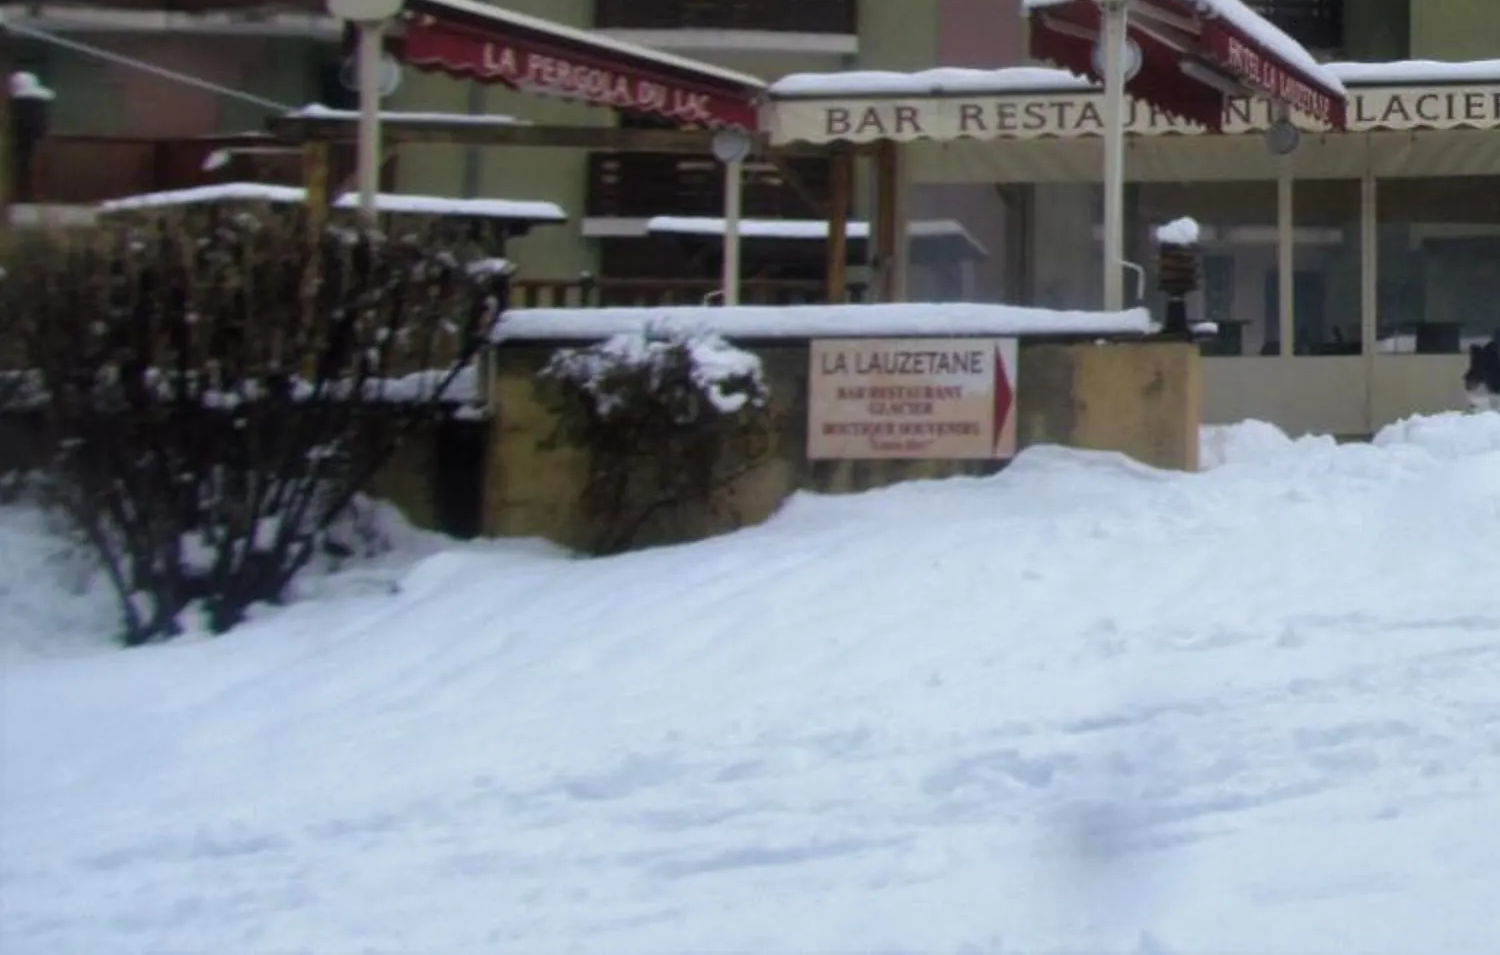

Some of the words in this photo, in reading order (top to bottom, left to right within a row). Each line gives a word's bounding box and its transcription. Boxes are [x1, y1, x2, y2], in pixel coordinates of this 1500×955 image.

[483, 41, 517, 75] LA
[526, 51, 632, 103] PERGOLA
[637, 79, 669, 107] DU
[673, 88, 711, 122] LAC
[825, 107, 922, 134] BAR
[959, 96, 1273, 130] RESTANT
[821, 353, 849, 375] LA
[854, 351, 984, 375] LAUZETANE
